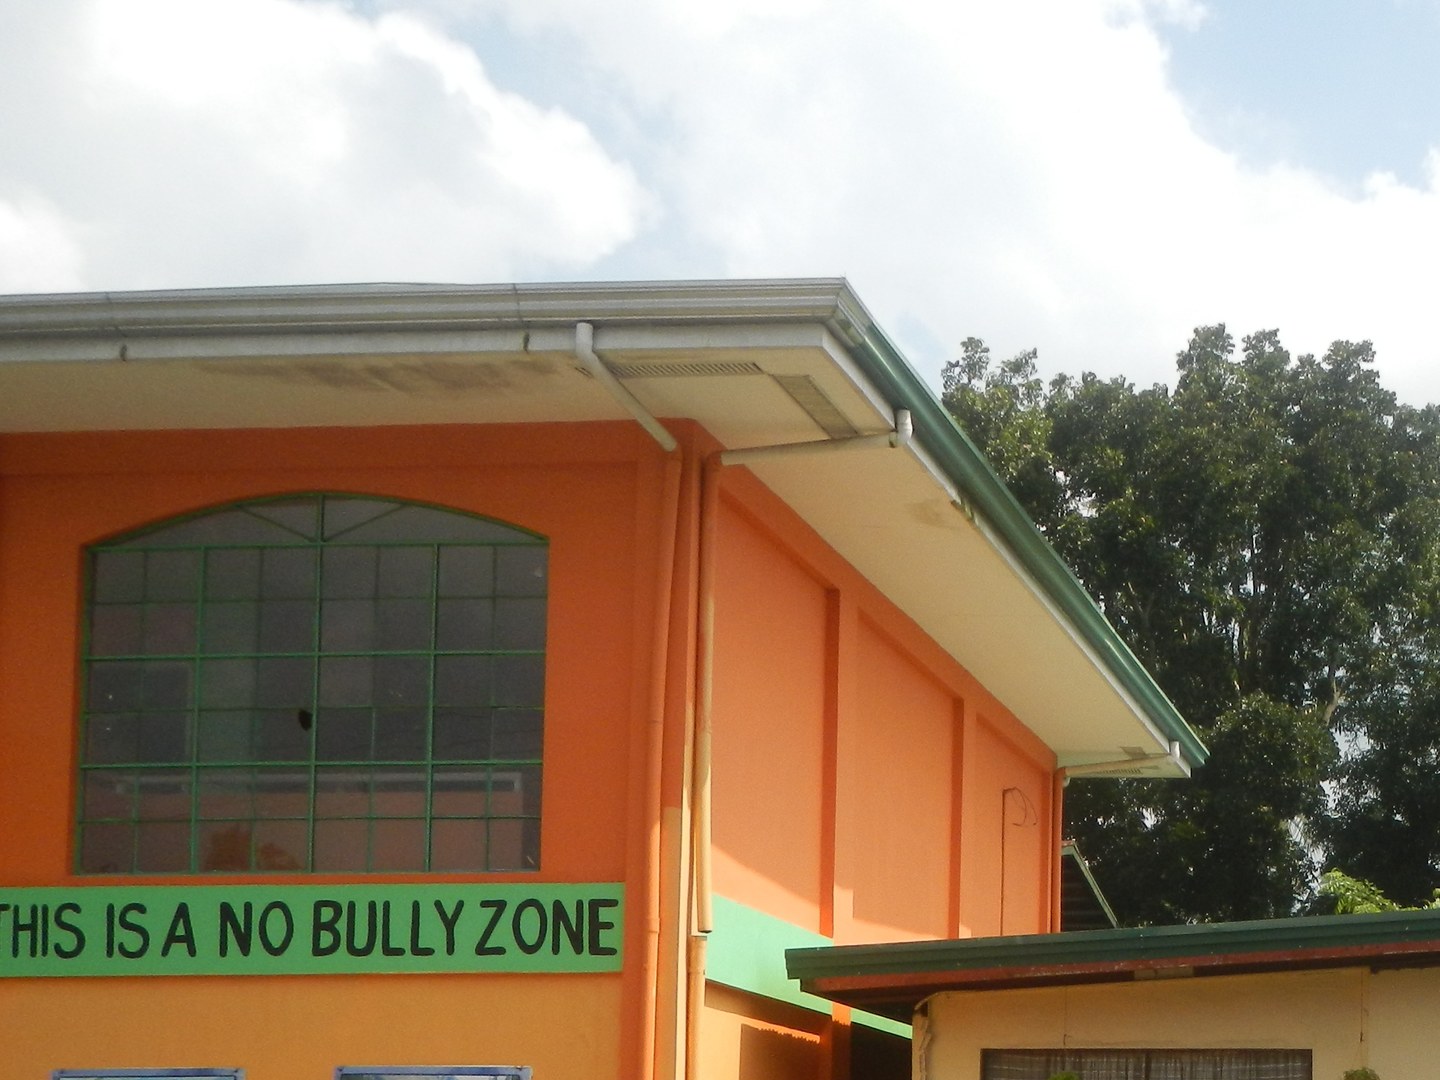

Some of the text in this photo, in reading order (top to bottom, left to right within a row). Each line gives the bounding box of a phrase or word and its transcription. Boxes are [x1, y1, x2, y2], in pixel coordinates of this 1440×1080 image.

[0, 898, 619, 959] HIS IS A NO BULLY ZONE
